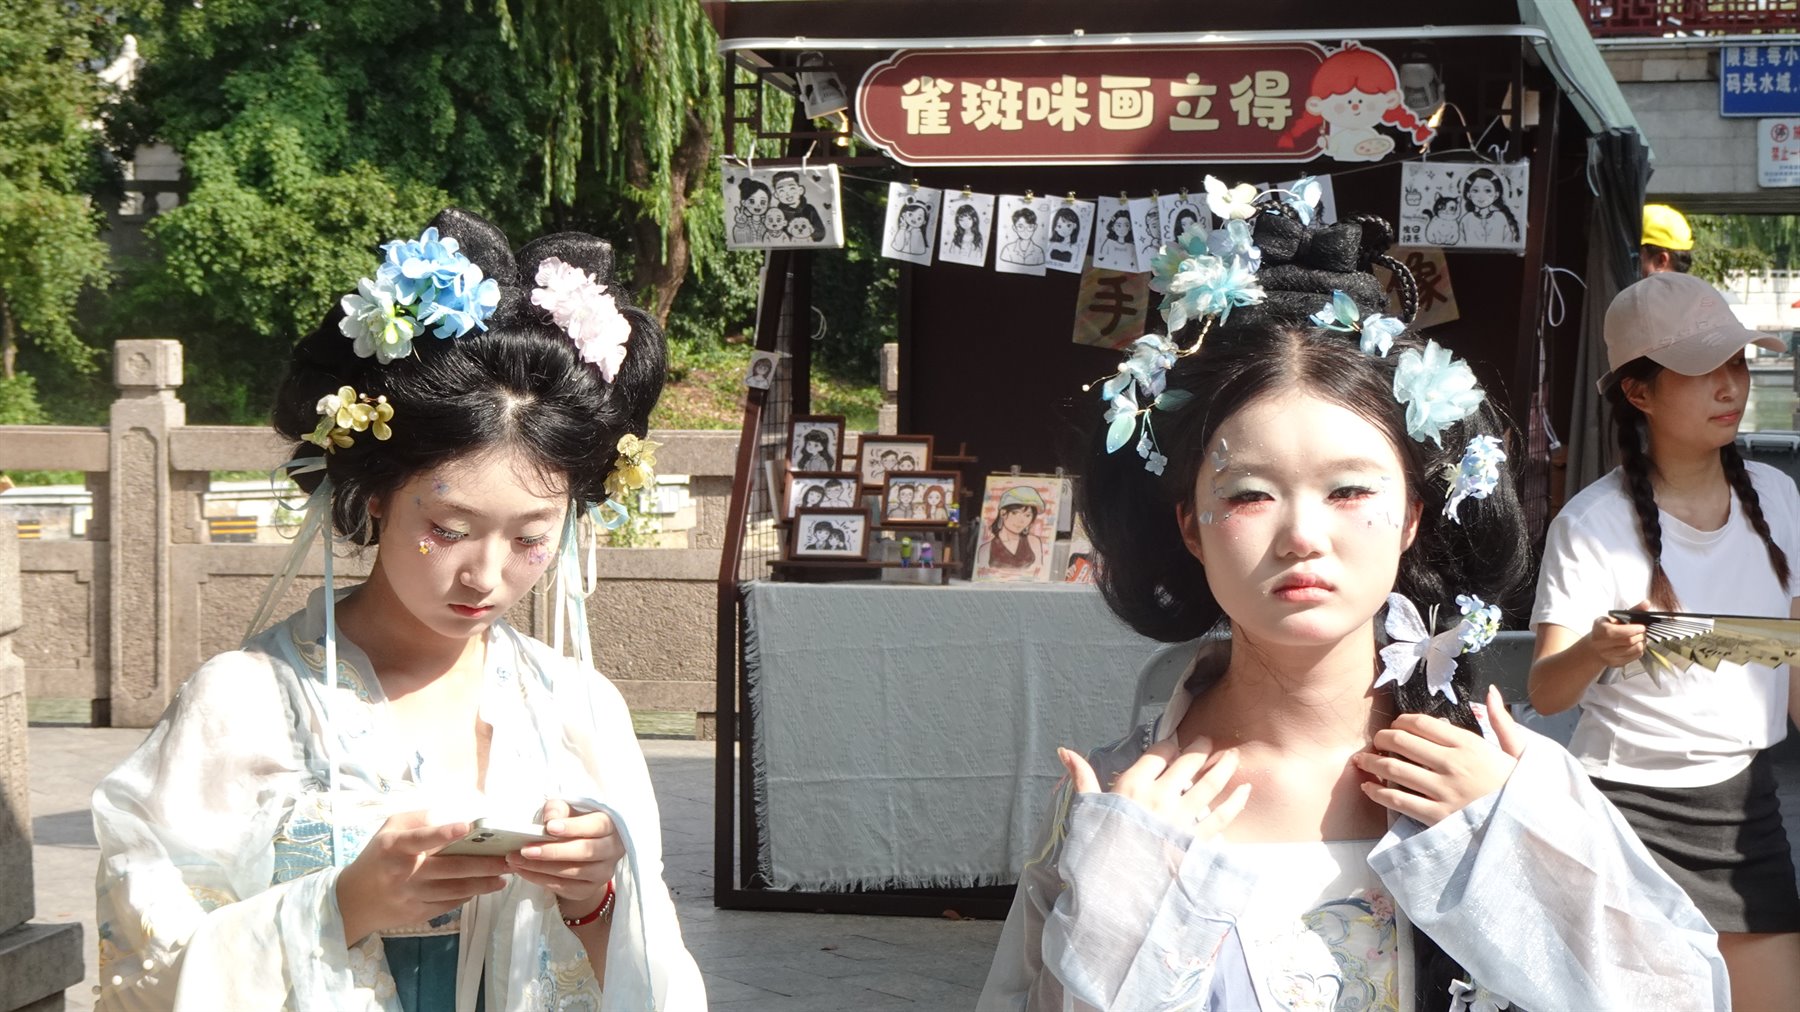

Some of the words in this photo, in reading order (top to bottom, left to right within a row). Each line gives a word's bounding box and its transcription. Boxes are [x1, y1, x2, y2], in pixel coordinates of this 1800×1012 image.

[901, 70, 1293, 135] 雀斑咪画立得
[1088, 275, 1138, 336] 手
